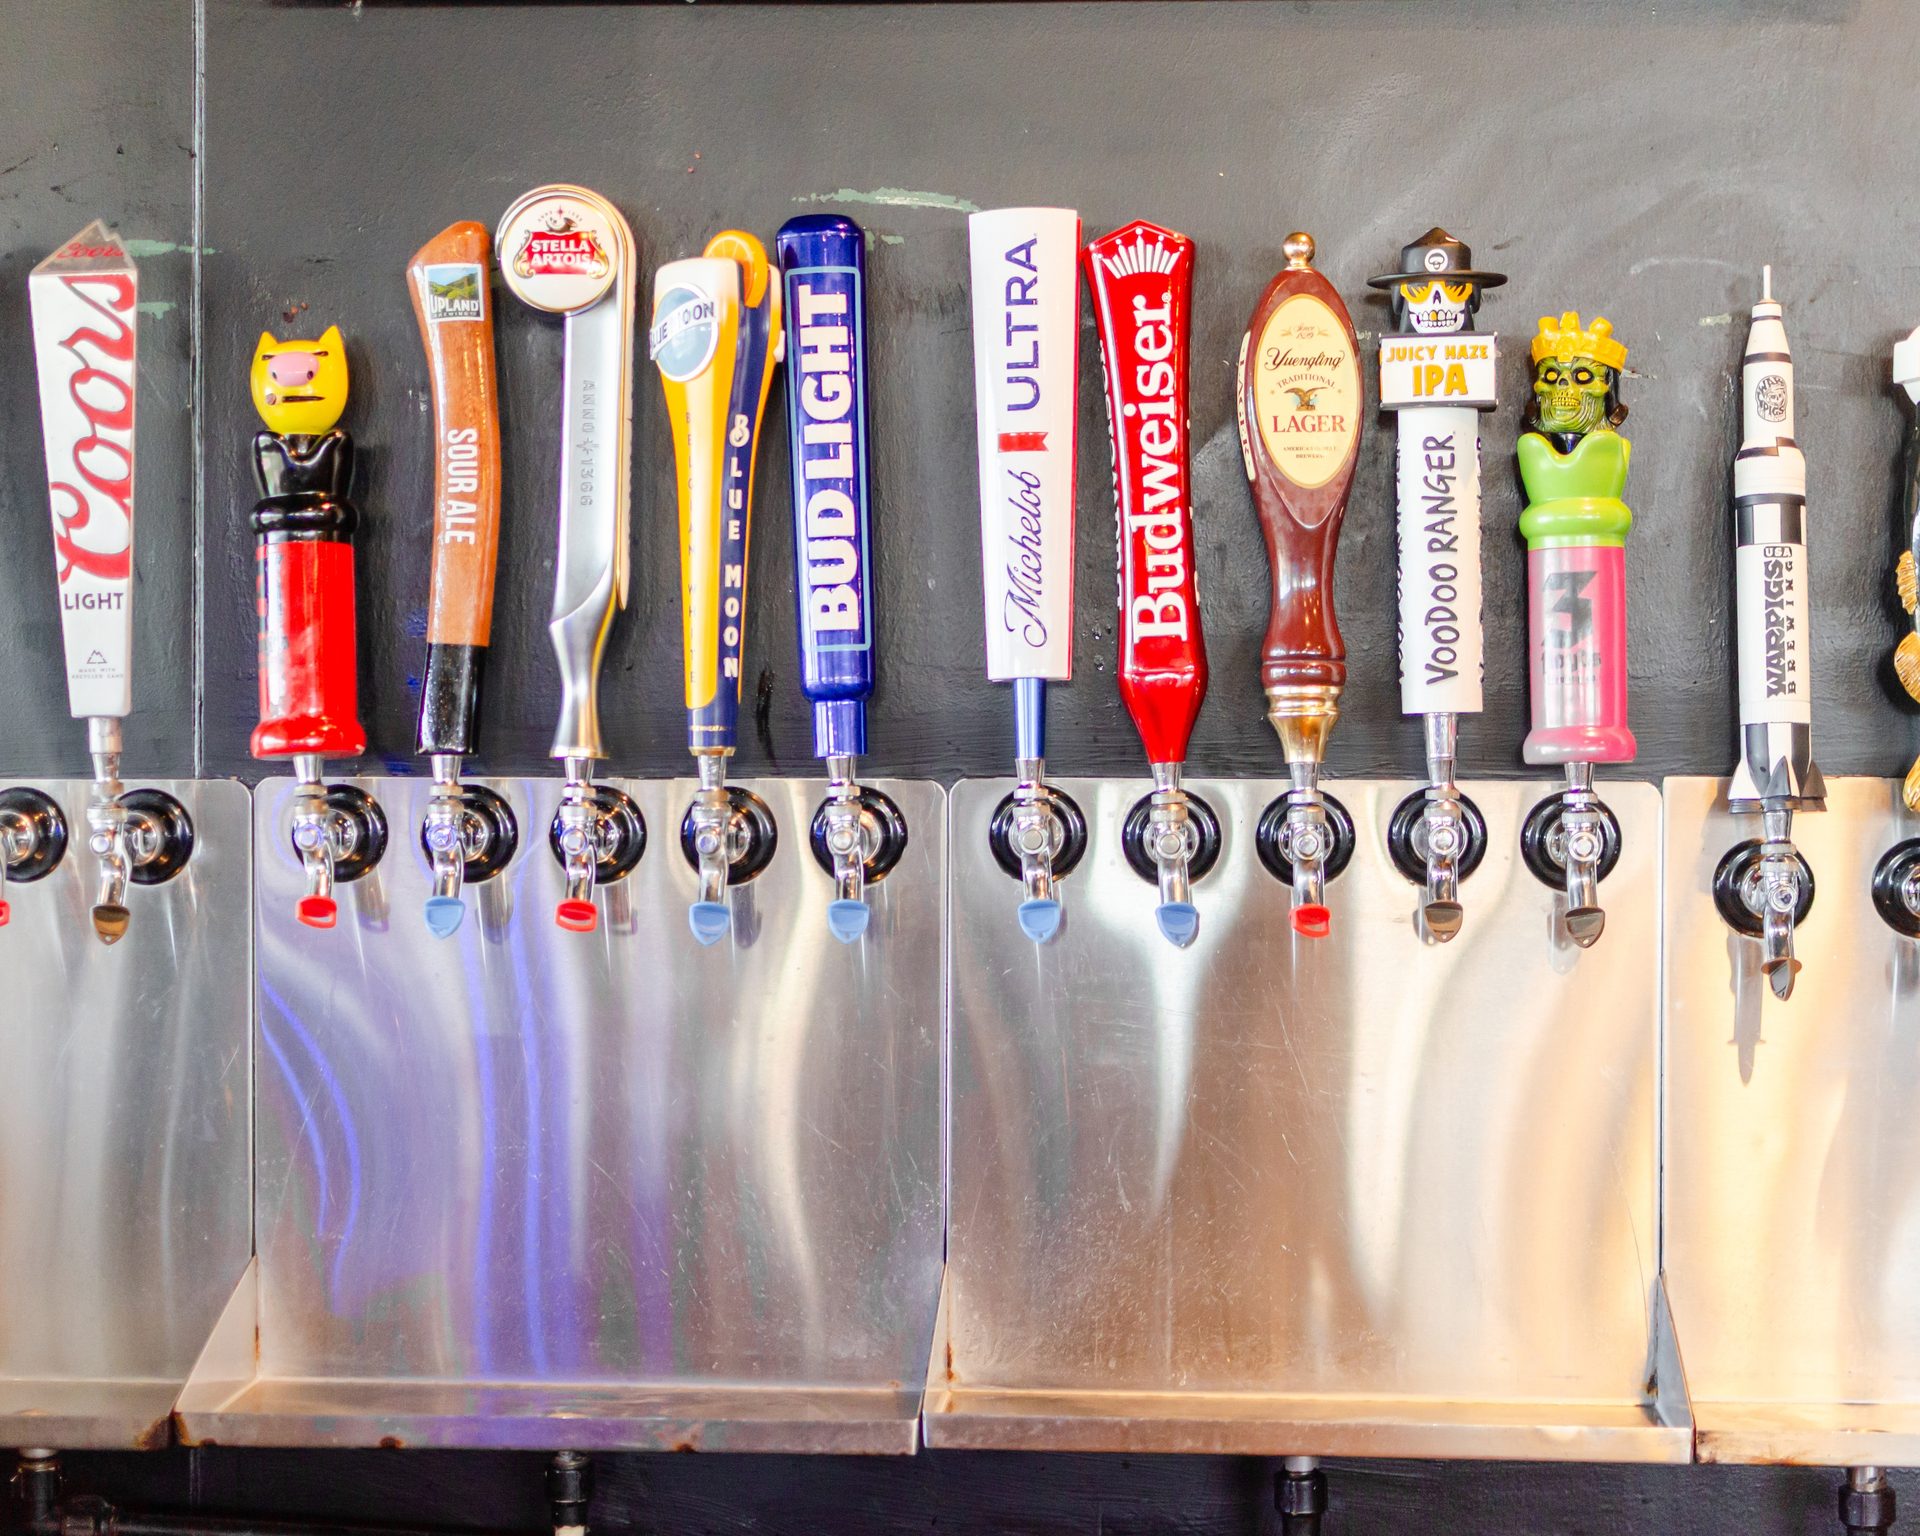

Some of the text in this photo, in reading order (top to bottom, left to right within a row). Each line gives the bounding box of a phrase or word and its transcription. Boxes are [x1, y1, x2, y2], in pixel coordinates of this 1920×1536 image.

[531, 240, 591, 252] STELLA
[530, 253, 591, 268] ARTOIS
[430, 295, 479, 313] UPLAND
[677, 301, 714, 327] OON
[1264, 347, 1346, 371] Yuengling
[1386, 344, 1488, 363] JUICY HAZE
[1276, 373, 1336, 390] TRADITIONAL
[1412, 363, 1468, 397] IPA
[1763, 402, 1785, 416] PIGS
[50, 274, 135, 584] Coors
[1272, 415, 1347, 433] LAGER
[1004, 238, 1049, 649] Michelob ULTRA
[798, 284, 859, 632] BUD LIGHT
[1124, 294, 1188, 644] Budweiser
[445, 428, 478, 545] SOUR ALE
[723, 414, 750, 678] BLUE MOON
[1765, 547, 1792, 557] USA
[1421, 435, 1460, 686] VOODOO RANGER
[64, 592, 124, 610] LIGHT
[1764, 559, 1787, 699] WARPIGS
[1786, 560, 1797, 694] BREWING
